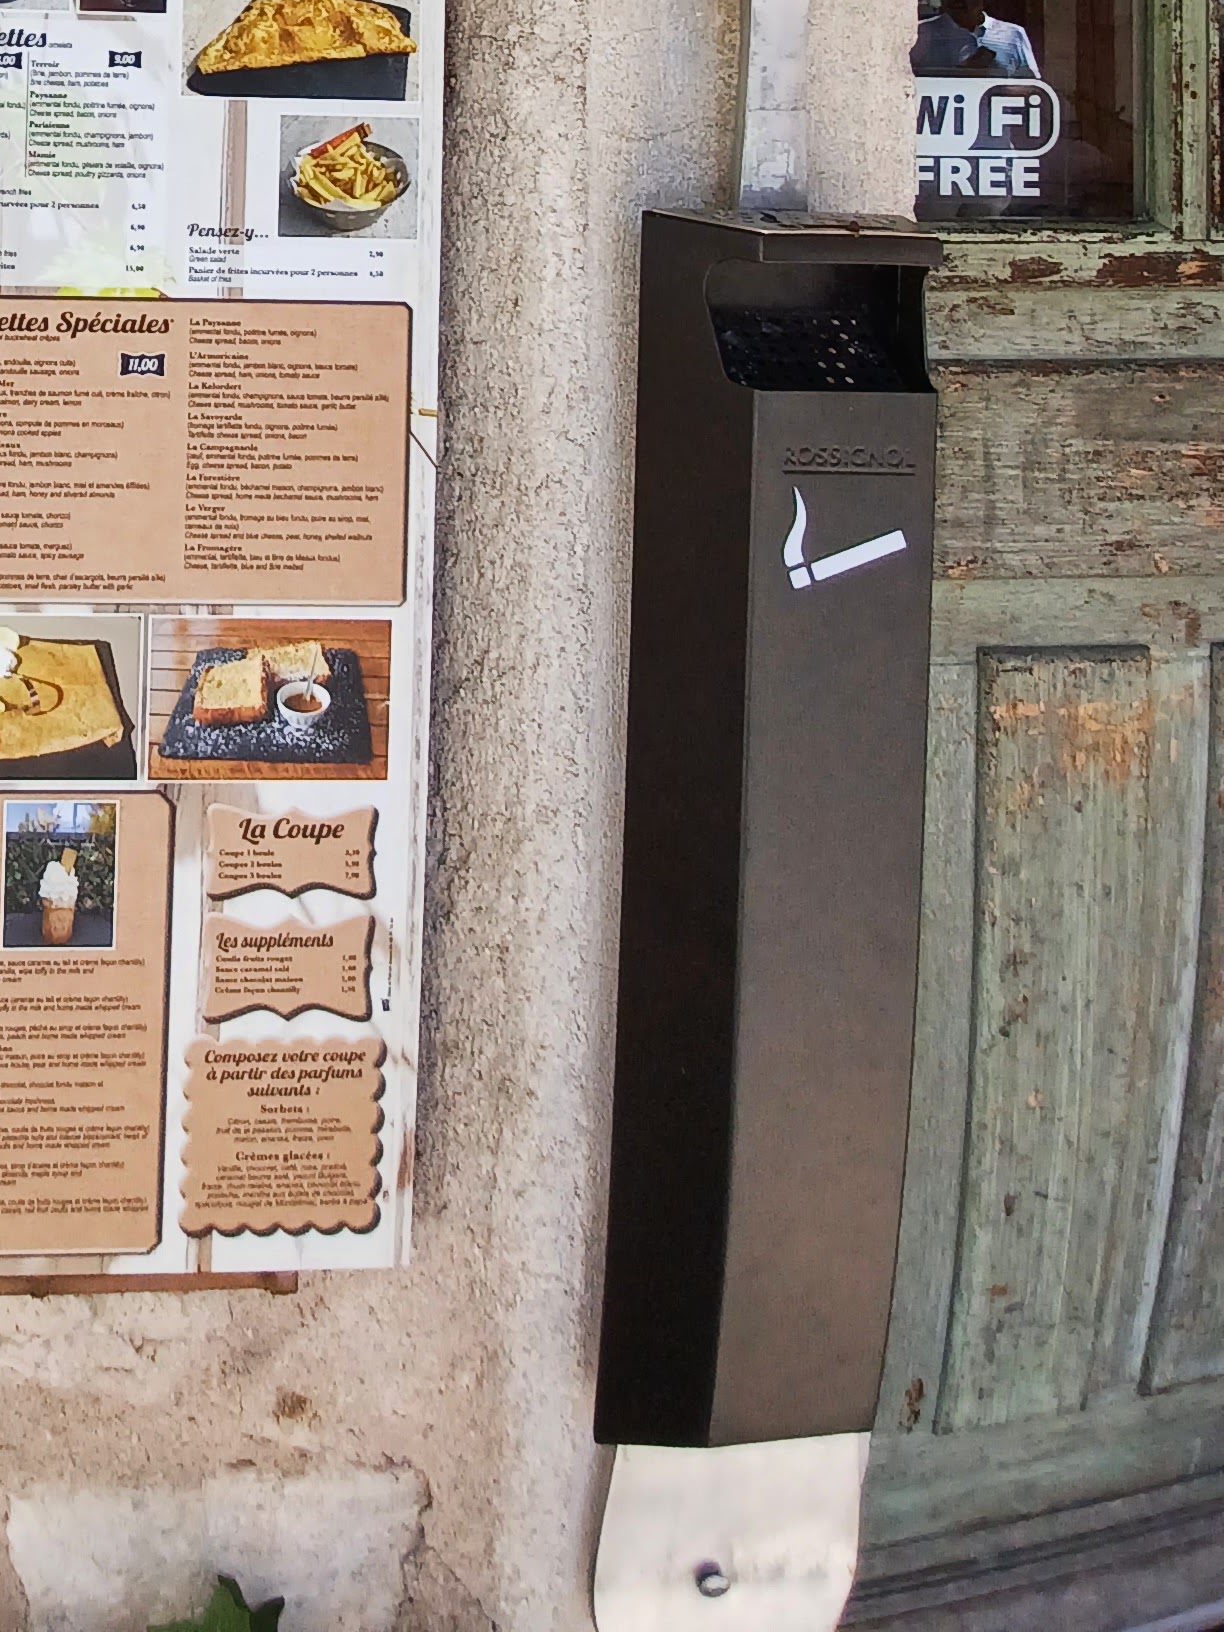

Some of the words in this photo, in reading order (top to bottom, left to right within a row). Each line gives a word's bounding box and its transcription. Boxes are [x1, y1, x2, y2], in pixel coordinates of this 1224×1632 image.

[916, 158, 1040, 196] FREE
[56, 311, 170, 338] Spéciales
[128, 359, 158, 372] 11,00
[239, 818, 266, 845] La
[273, 818, 344, 845] Coupe
[216, 933, 237, 952] Les
[241, 932, 334, 952] suppléments
[205, 1050, 277, 1066] Composez
[282, 1050, 319, 1063] votre
[323, 1050, 366, 1065] coupe
[206, 1067, 216, 1080] à
[220, 1068, 268, 1083] partir
[271, 1067, 295, 1080] des
[297, 1067, 363, 1083] parfums
[261, 1105, 303, 1113] Sorbets
[236, 1152, 279, 1161] Crèmes
[283, 1151, 323, 1163] glacées
